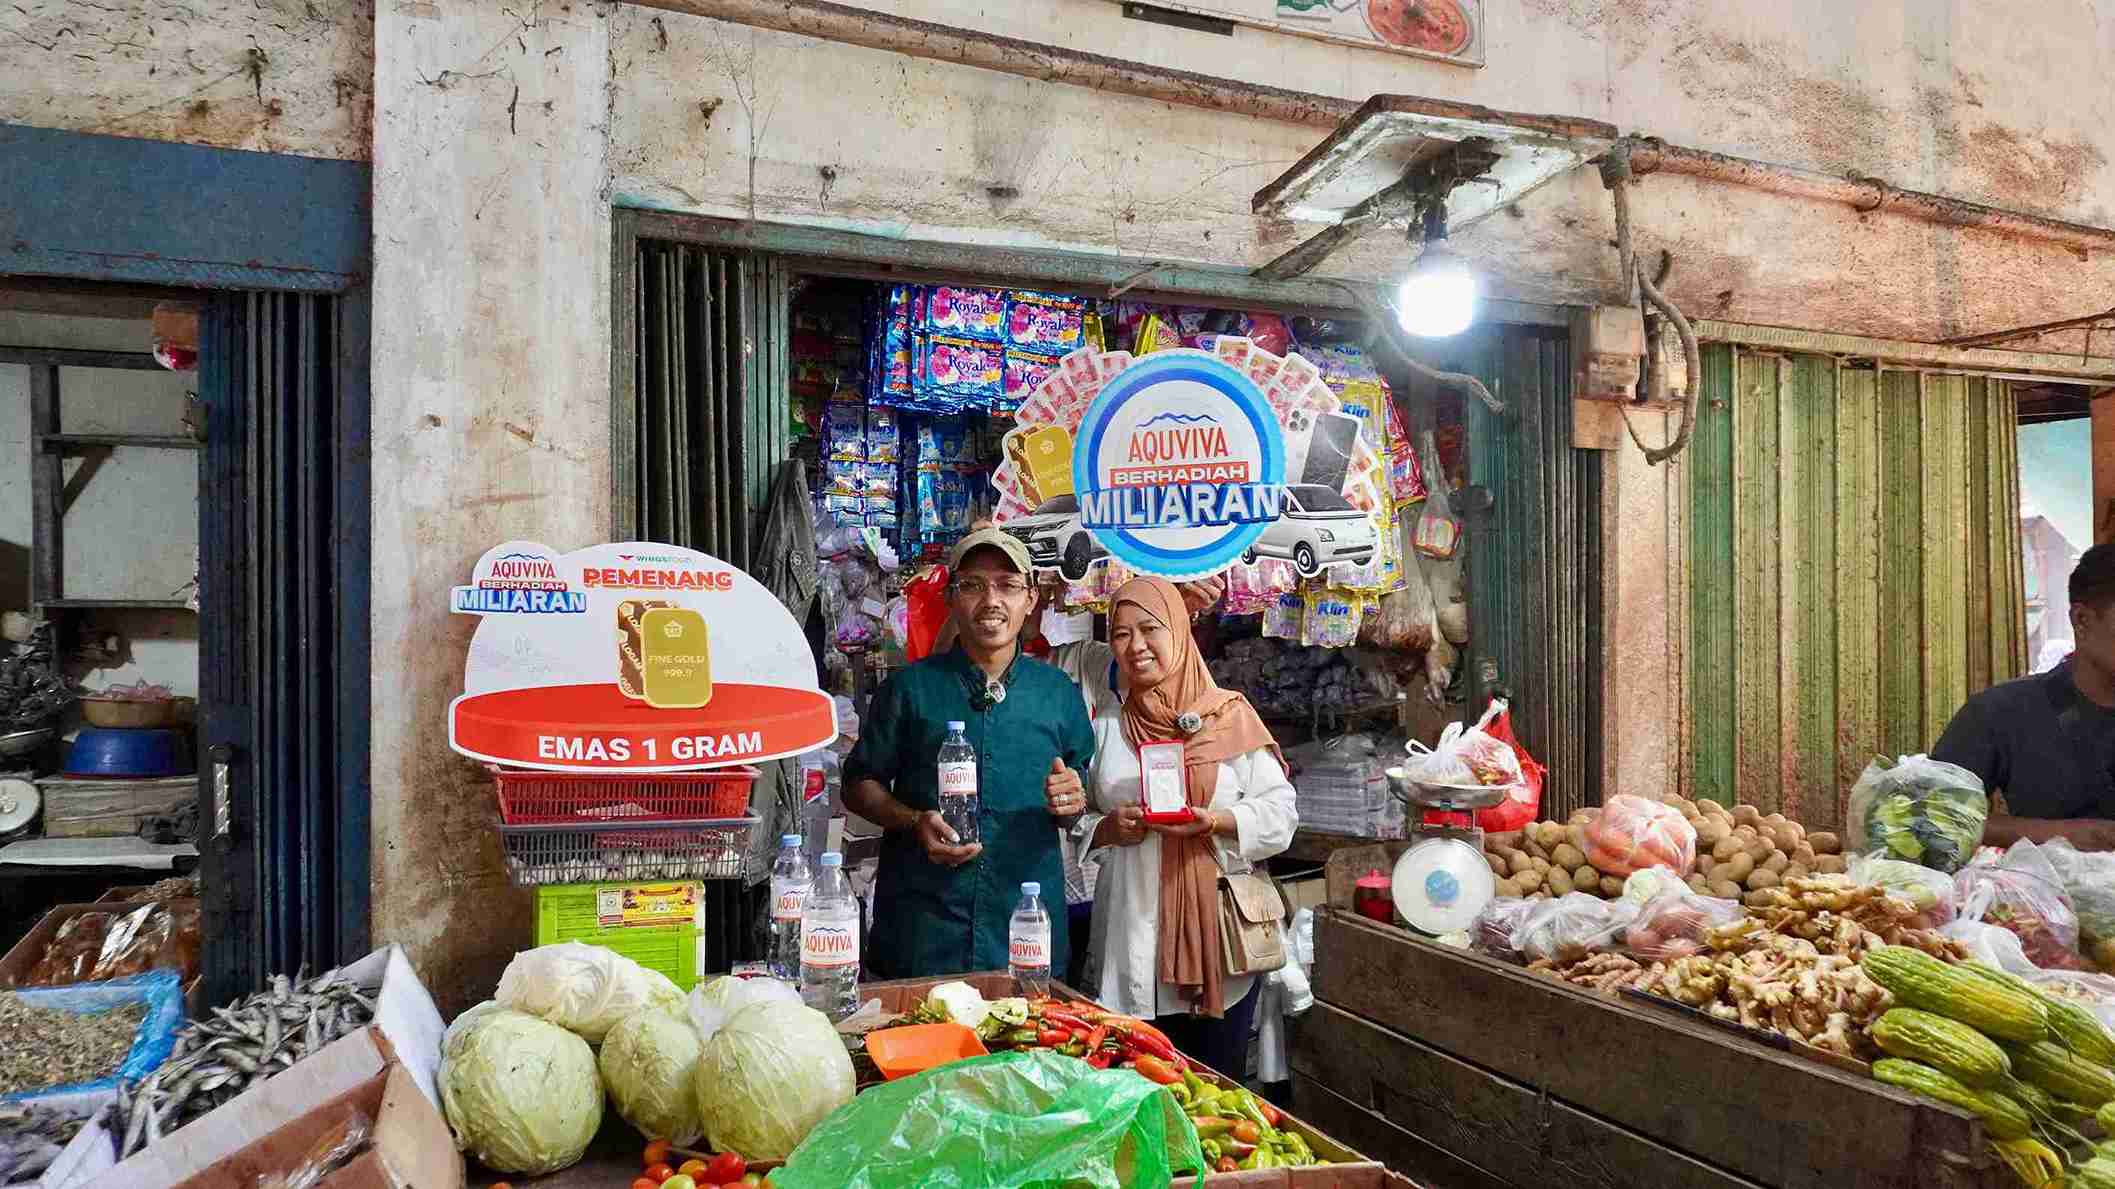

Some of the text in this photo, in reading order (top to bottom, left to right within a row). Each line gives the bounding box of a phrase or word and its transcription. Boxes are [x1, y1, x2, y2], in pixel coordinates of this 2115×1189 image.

[1128, 426, 1229, 463] AQUVIVA
[1114, 463, 1246, 484] BERHADIAH
[1081, 483, 1280, 528] MILIARAN
[491, 561, 556, 578] AQUVIVA
[583, 567, 733, 591] PEMENANG
[481, 580, 567, 592] BERHADIAH
[457, 589, 587, 613] MILIARAN
[539, 731, 763, 761] EMAS 1 GRAM
[804, 935, 852, 953] AQUVIVA
